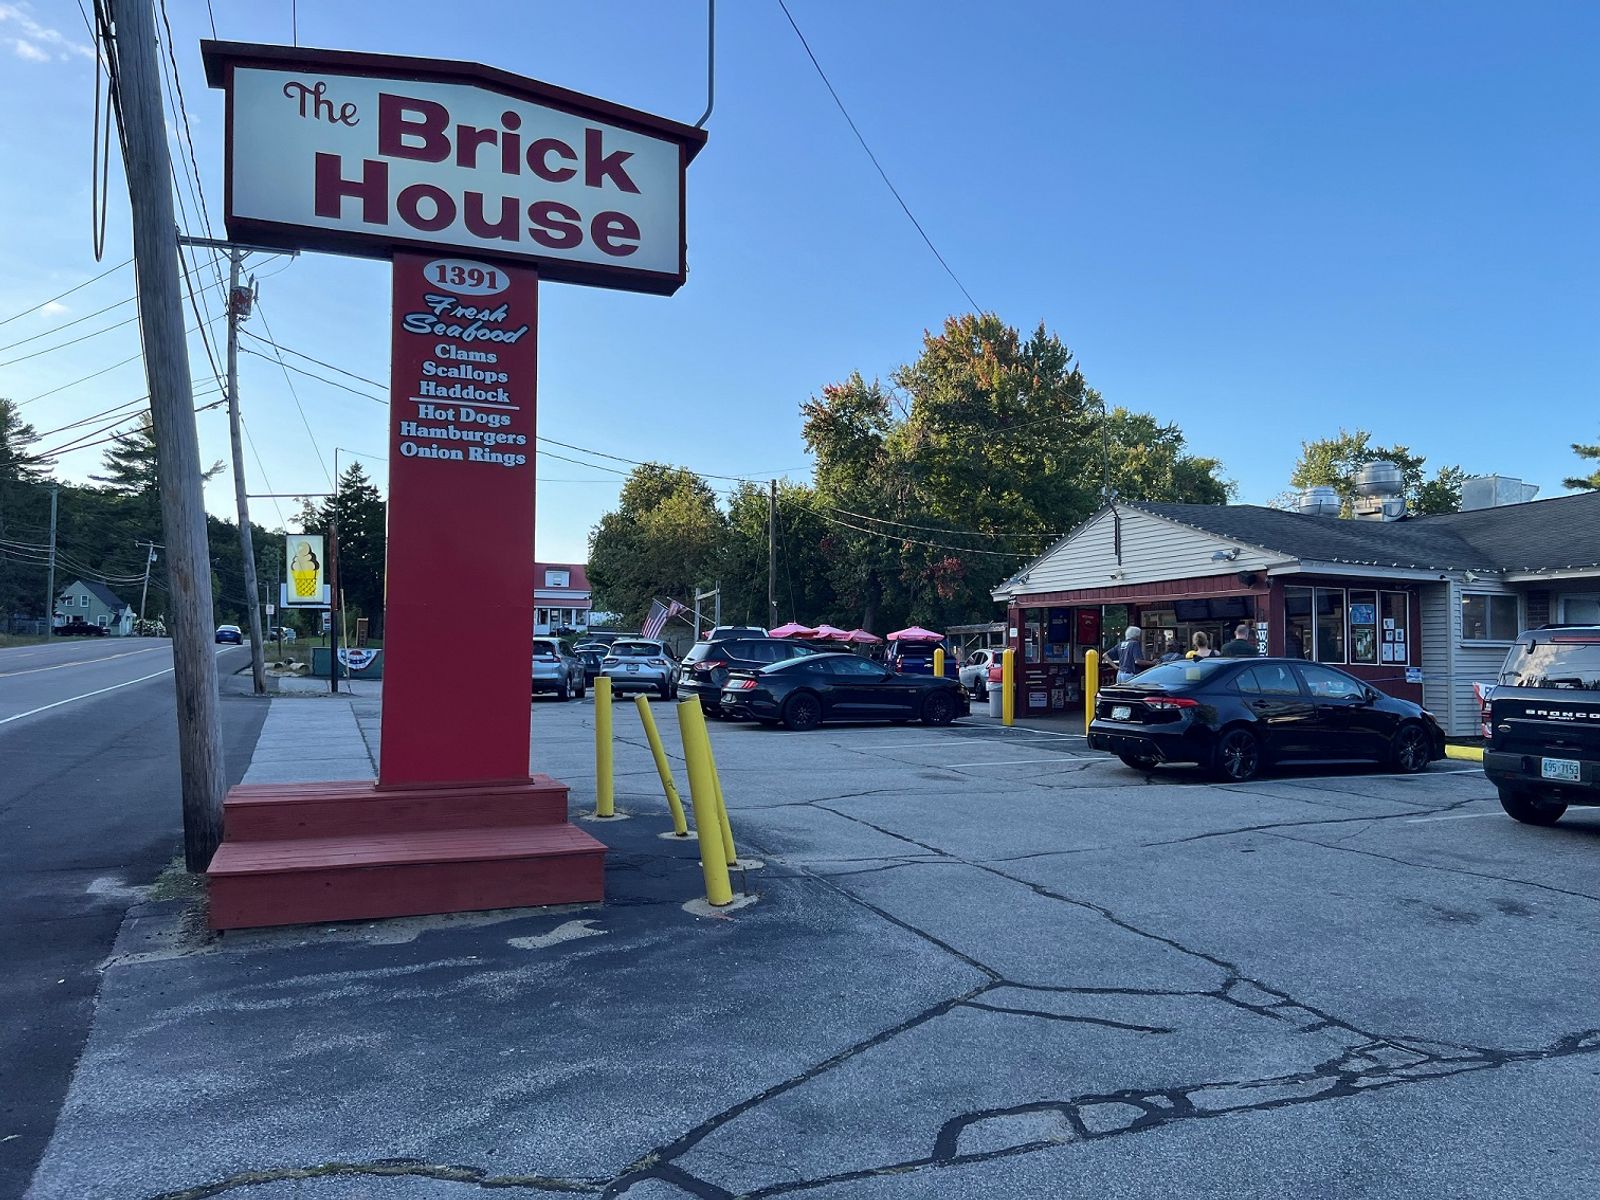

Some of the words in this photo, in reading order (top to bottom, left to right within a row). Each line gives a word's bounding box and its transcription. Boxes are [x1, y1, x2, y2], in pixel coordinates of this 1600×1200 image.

[283, 80, 360, 127] The
[378, 91, 642, 195] Brick
[314, 151, 641, 257] House
[435, 264, 499, 290] 1391
[425, 294, 509, 323] Fresh
[403, 313, 529, 344] Seafood
[434, 343, 498, 364] Clams
[422, 360, 509, 385] Scallops
[419, 380, 510, 403] Haddock
[418, 404, 455, 421] Hot
[459, 407, 511, 428] Dogs
[400, 421, 527, 446] Hamburgers
[400, 441, 464, 461] Onion
[468, 446, 526, 467] Rings
[1525, 709, 1600, 718] BRONCO
